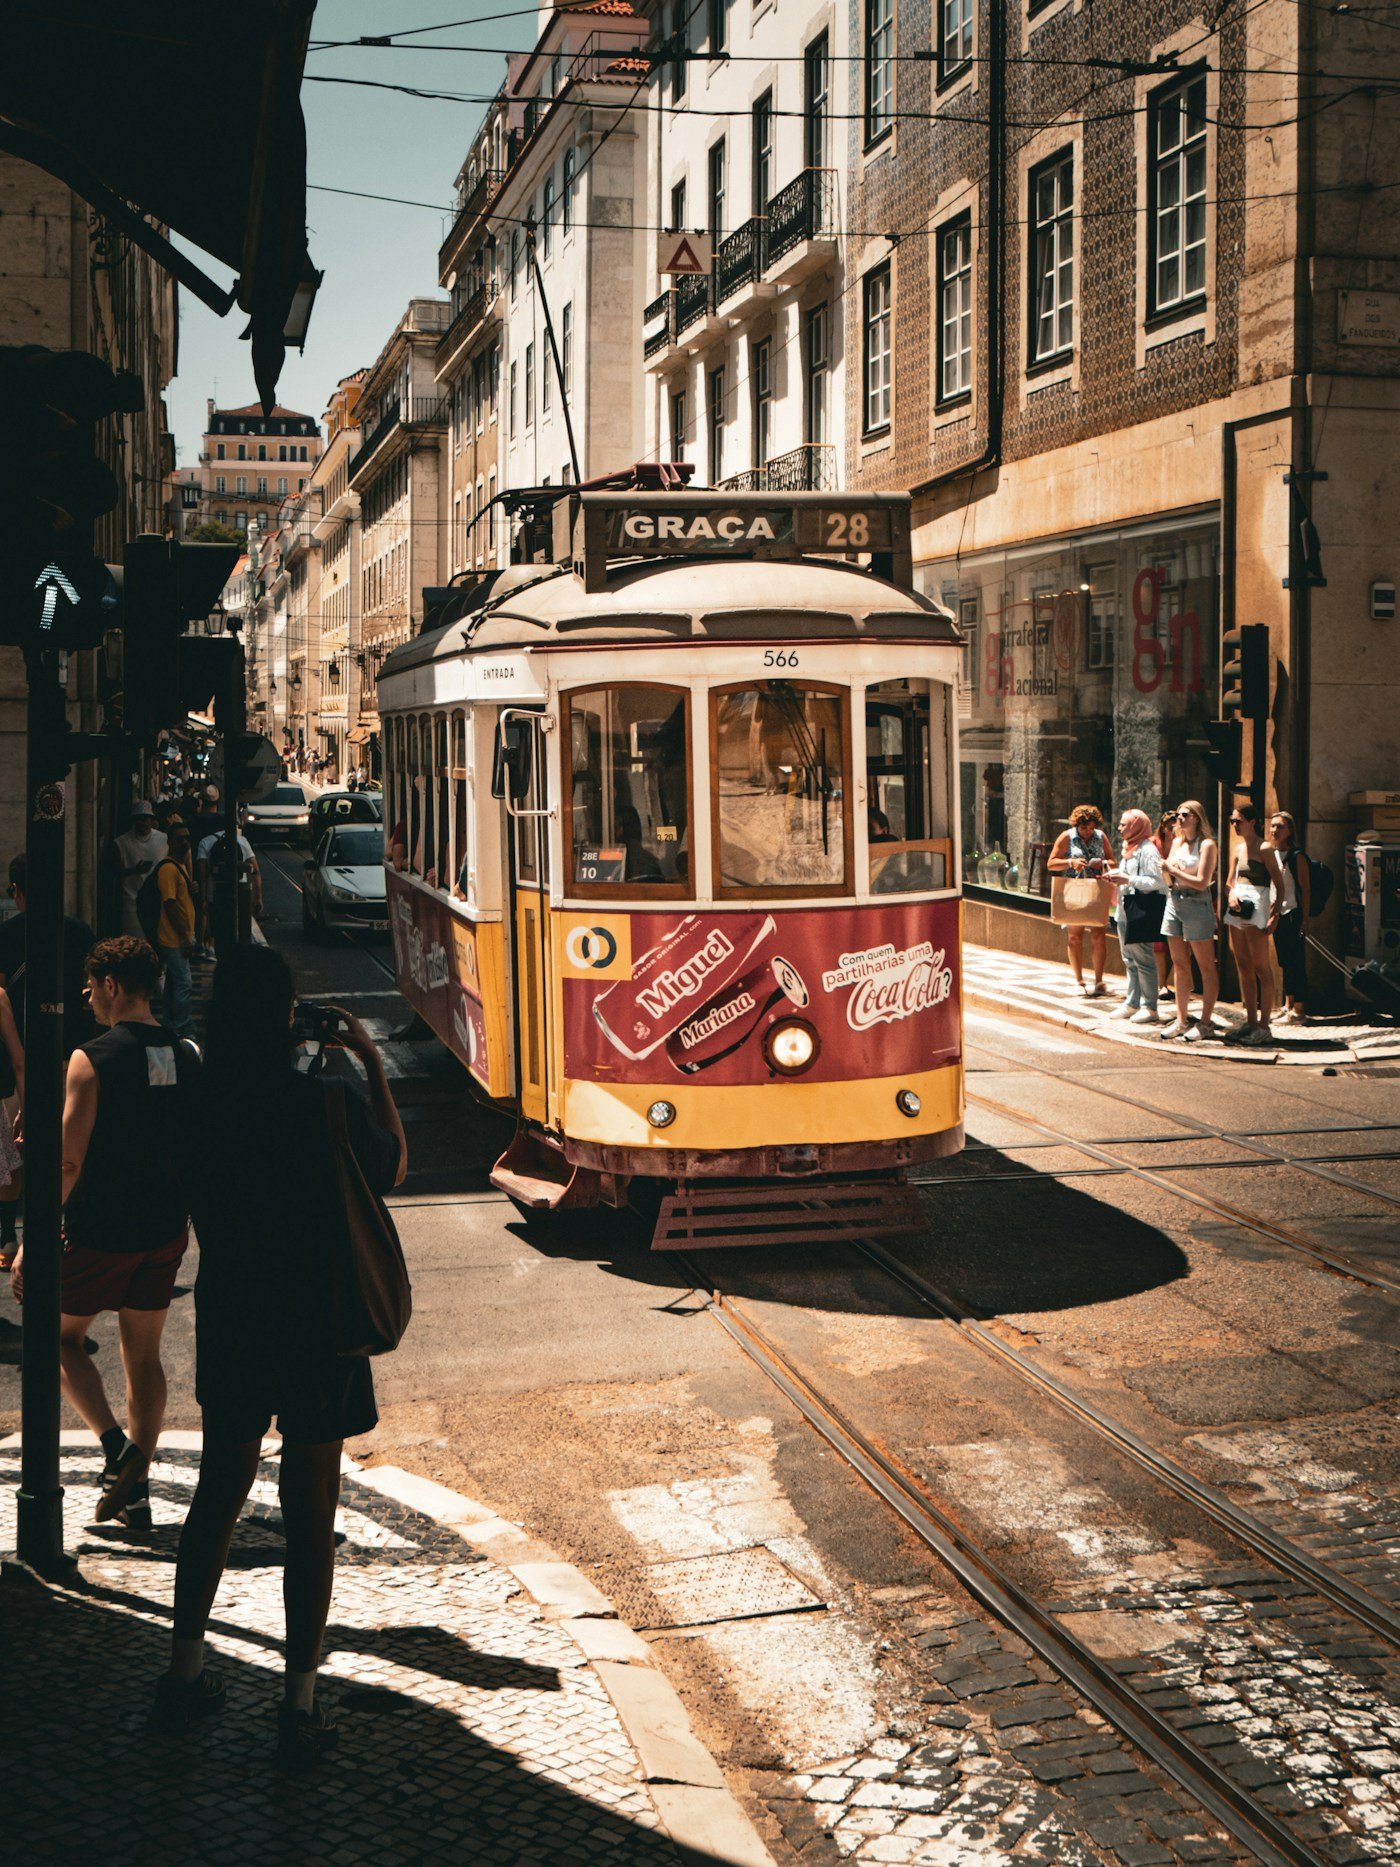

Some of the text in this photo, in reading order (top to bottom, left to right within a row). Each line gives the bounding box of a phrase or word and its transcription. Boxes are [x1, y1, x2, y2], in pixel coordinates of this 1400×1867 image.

[624, 516, 775, 545] GRAÇA
[826, 512, 870, 547] 28
[483, 667, 515, 680] ENTRADA
[763, 650, 799, 668] 566
[582, 851, 598, 861] 28E
[581, 867, 597, 879] 10
[633, 959, 657, 980] SABOR
[657, 930, 690, 960] ORIGINAL
[826, 944, 932, 988] partilharias uma
[842, 946, 893, 966] Com quem
[637, 930, 734, 1018] Miguel
[681, 994, 754, 1048] Mariana
